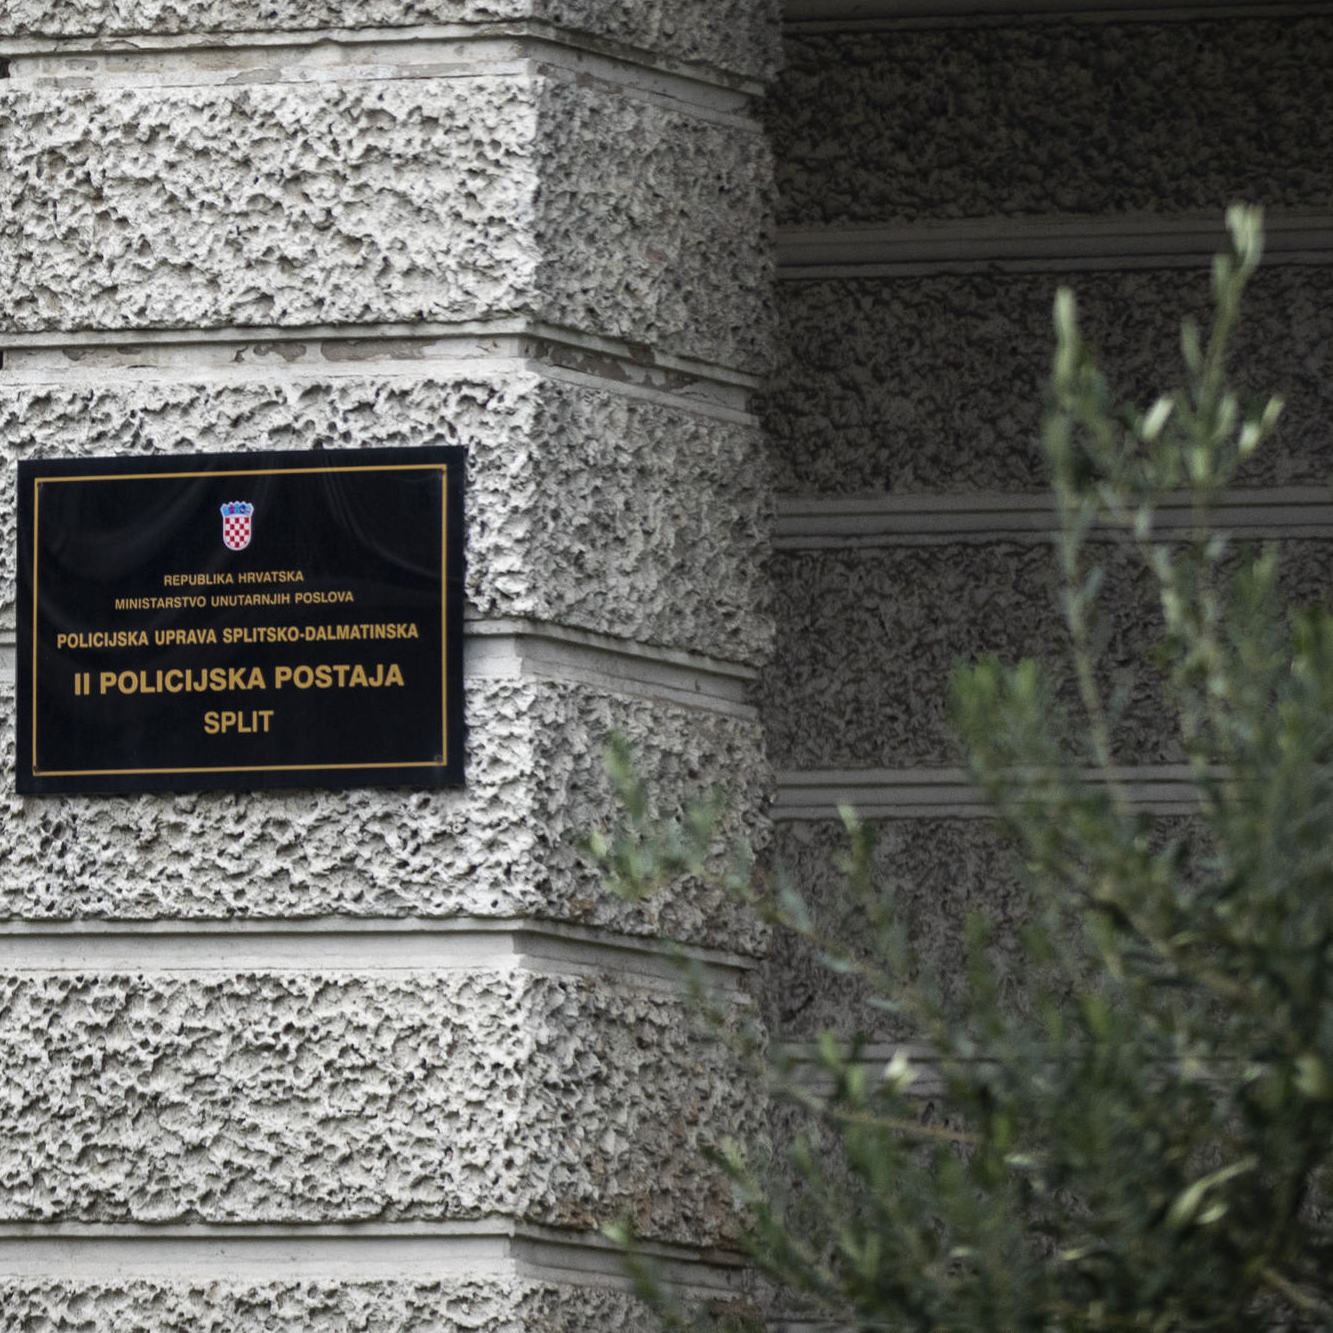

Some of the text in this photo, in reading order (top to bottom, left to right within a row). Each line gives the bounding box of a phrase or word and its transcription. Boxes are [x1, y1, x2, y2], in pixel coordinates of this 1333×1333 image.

[165, 571, 304, 586] REPUBLIKA HRVATSKA
[115, 591, 354, 609] MINISTARSTVO UNUTARNJIH POSLOVA
[57, 623, 418, 648] POLICIJSKA UPRAVA SPLITSKO-DALMATINSKA
[75, 664, 404, 695] II POLICIJSKA POSTAJA
[205, 710, 274, 734] SPLIT
